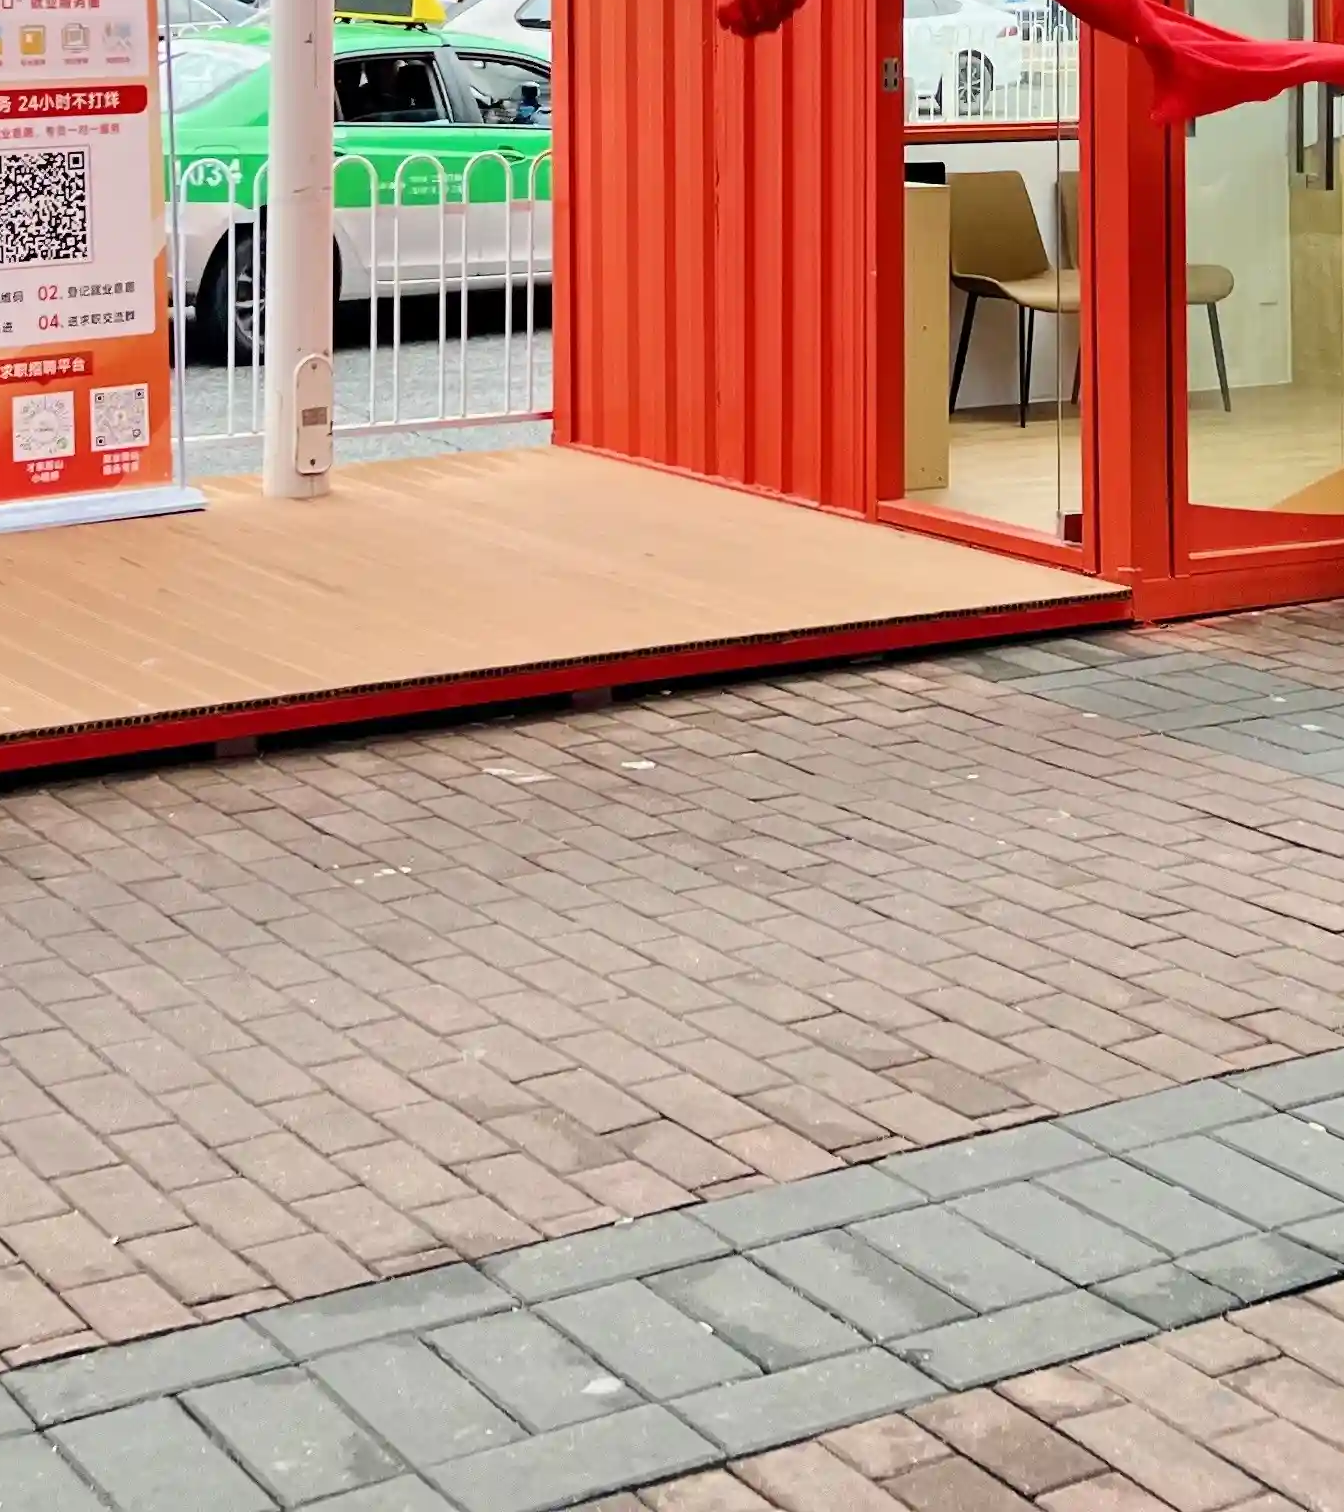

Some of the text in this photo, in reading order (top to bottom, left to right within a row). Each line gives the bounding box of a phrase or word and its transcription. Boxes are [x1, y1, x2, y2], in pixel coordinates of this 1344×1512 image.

[17, 91, 121, 112] 24小时不打烊
[0, 356, 87, 380] 求职招聘平台
